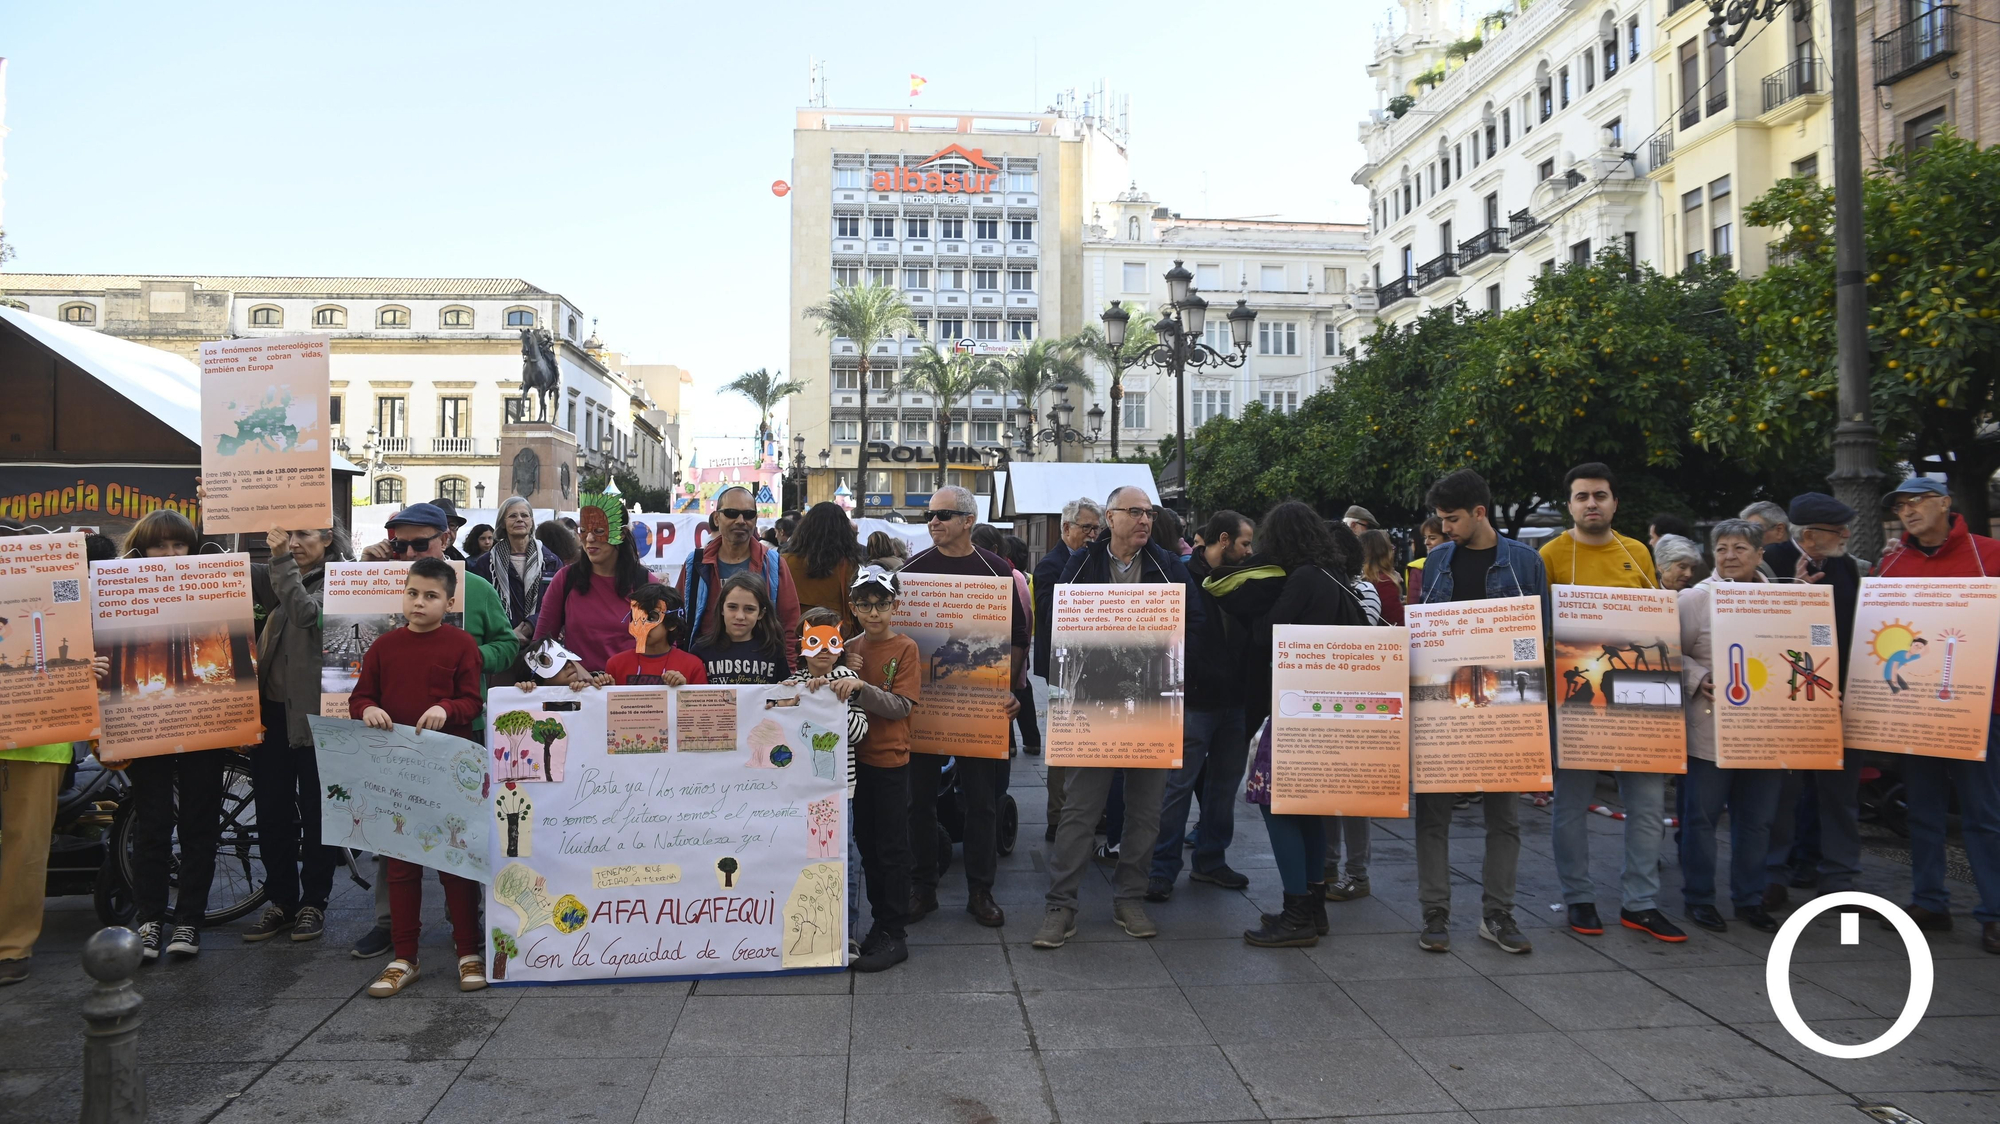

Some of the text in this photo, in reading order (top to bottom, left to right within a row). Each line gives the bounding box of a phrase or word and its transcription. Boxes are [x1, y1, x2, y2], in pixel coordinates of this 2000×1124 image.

[873, 166, 998, 192] albasur
[903, 194, 967, 204] inmobiliarias
[267, 342, 323, 352] metereológicos
[248, 364, 273, 372] Europa
[867, 442, 1007, 464] ROLWIN
[15, 553, 62, 562] muertes
[31, 563, 79, 573] "suaves"
[97, 567, 129, 575] Desde
[138, 564, 167, 573] 1980,
[198, 560, 244, 569] incendios
[98, 576, 149, 586] forestales
[181, 572, 226, 581] devorado
[964, 582, 997, 590] petróleo,
[99, 599, 127, 607] como
[199, 591, 246, 601] superficie
[1611, 594, 1657, 602] AMBIENTAL
[1425, 609, 1460, 617] medidas
[1462, 606, 1508, 615] adecuadas
[1603, 603, 1633, 611] SOCIAL
[1411, 631, 1437, 640] podría
[680, 782, 716, 795] niños
[712, 783, 731, 811] y
[734, 779, 778, 792] niñas
[543, 816, 557, 826] no
[563, 814, 597, 826] somos
[602, 810, 620, 824] el
[677, 810, 717, 821] somos
[724, 803, 748, 820] el
[633, 831, 646, 849] la
[654, 828, 736, 849] Naturaleza
[591, 899, 648, 924] AFA
[525, 936, 563, 968] Con
[572, 932, 595, 966] la
[600, 937, 686, 976] Capacidad
[697, 939, 720, 959] de
